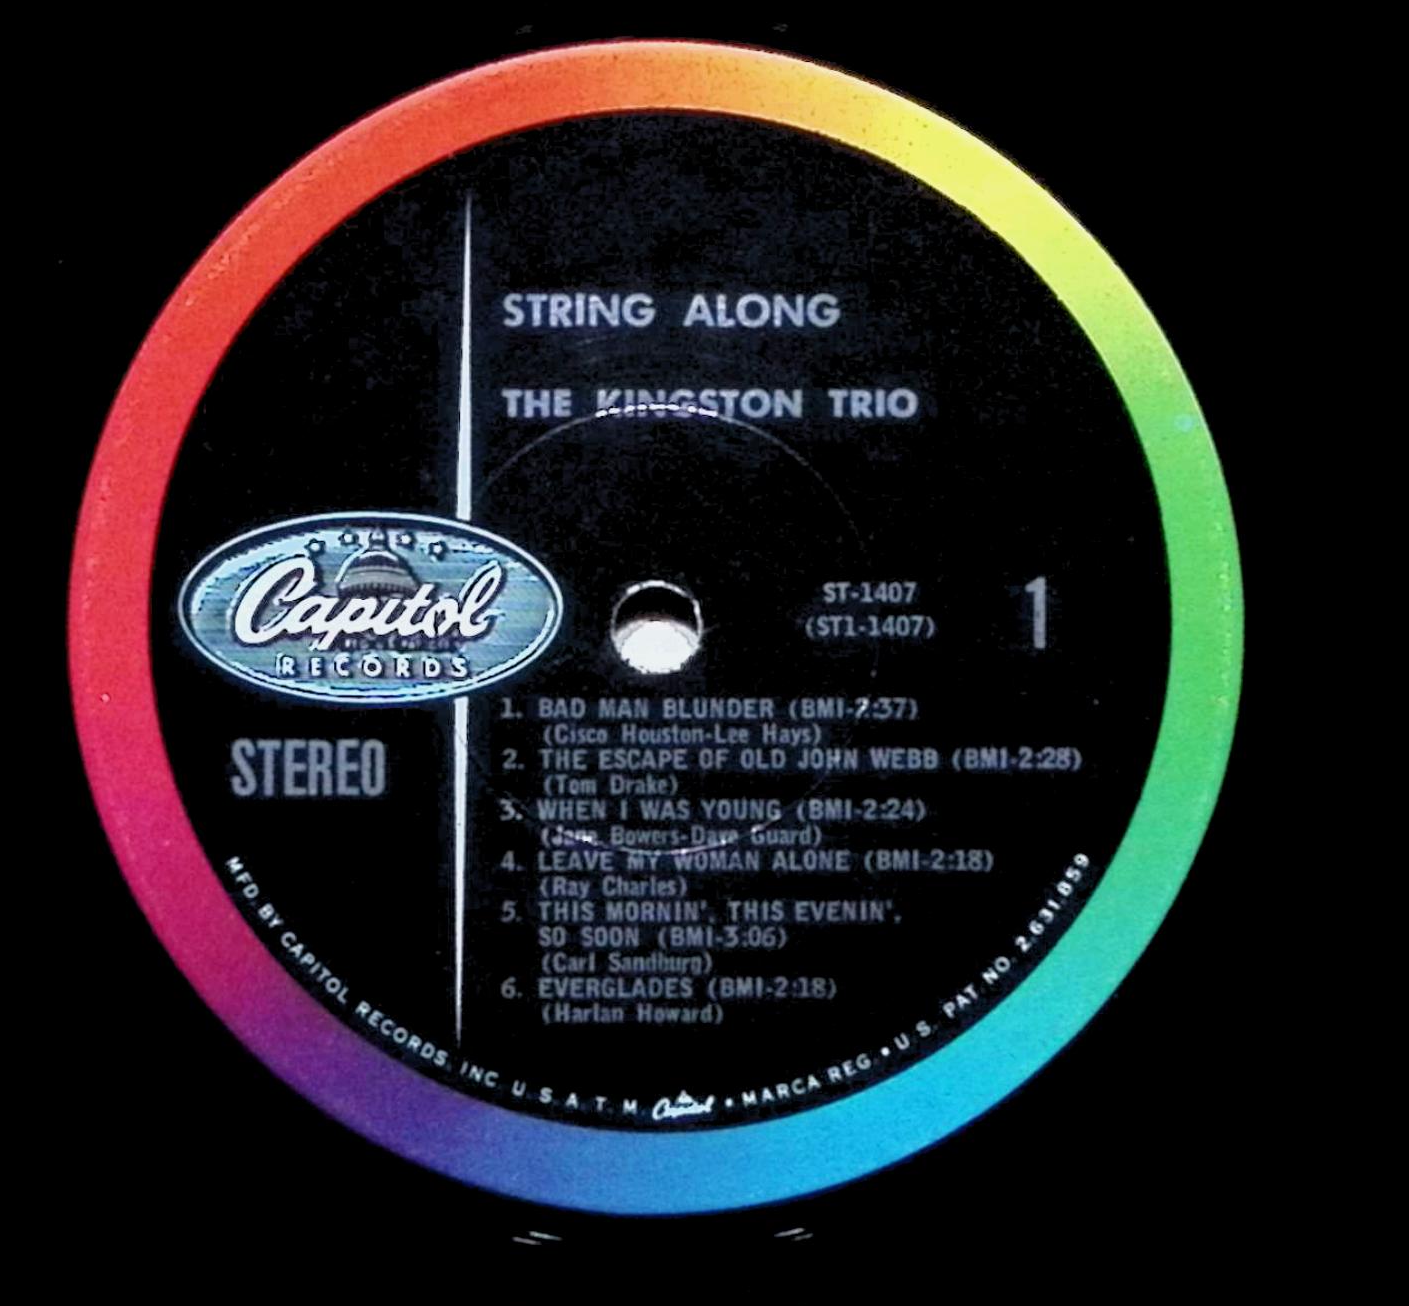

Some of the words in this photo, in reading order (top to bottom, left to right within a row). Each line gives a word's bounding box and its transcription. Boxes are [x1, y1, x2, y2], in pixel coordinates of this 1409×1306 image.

[503, 293, 656, 327] STRING
[683, 293, 840, 328] ALONG
[502, 389, 572, 418] THE
[598, 389, 802, 418] KINGSTON
[828, 388, 918, 418] TRIO
[823, 582, 916, 603] ST-1407
[235, 560, 503, 651] Capitol
[1025, 577, 1046, 648] 1
[806, 615, 935, 637] (ST1-1407)
[278, 656, 471, 679] RECORDS
[501, 697, 522, 718] 1.
[538, 697, 586, 719] BAD
[598, 698, 649, 719] MAN
[662, 698, 774, 719] BLUNDER
[544, 723, 608, 746] (Cisco
[621, 723, 750, 747] Houston-Lee
[762, 723, 822, 748] Hays)
[231, 739, 385, 796] STEREO
[503, 749, 524, 769] 2.
[540, 748, 588, 770] THE
[598, 748, 688, 770] ESCAPE
[699, 748, 730, 770] OF
[740, 748, 786, 770] OLD
[796, 748, 858, 770] JOHN
[870, 748, 938, 769] WEBB
[952, 747, 1081, 770] (BMI-2:28)
[544, 774, 597, 796] (Tom
[610, 774, 678, 795] Drake)
[500, 799, 522, 820] 3.
[537, 799, 606, 821] WHEN
[620, 799, 627, 820] I
[640, 799, 690, 820] WAS
[701, 799, 781, 821] YOUNG
[796, 798, 926, 822] (BMI-2:24)
[750, 825, 822, 847] Guard)
[501, 851, 522, 871] 4.
[538, 850, 614, 872] LEAVE
[626, 850, 660, 871] MY
[673, 850, 759, 872] WOMAN
[772, 849, 850, 871] ALONE
[864, 849, 993, 871] (BMI-2:18)
[539, 876, 590, 898] (Ray
[602, 875, 687, 897] Charles)
[502, 901, 520, 922] 5.
[538, 900, 594, 922] THIS
[728, 900, 784, 922] THIS
[539, 926, 567, 947] SO
[580, 926, 639, 947] SOON
[658, 925, 787, 949] (BMI-3:06)
[542, 952, 595, 974] (Carl
[608, 952, 712, 975] Sandburg)
[501, 977, 521, 998] 6.
[539, 977, 693, 999] EVERGLADES
[708, 977, 836, 1000] (BMI-2:18)
[280, 931, 350, 1005] CAPITOL
[741, 1074, 822, 1107] MARCA
[542, 1003, 624, 1023] (Harlan
[637, 1003, 723, 1023] Howard)
